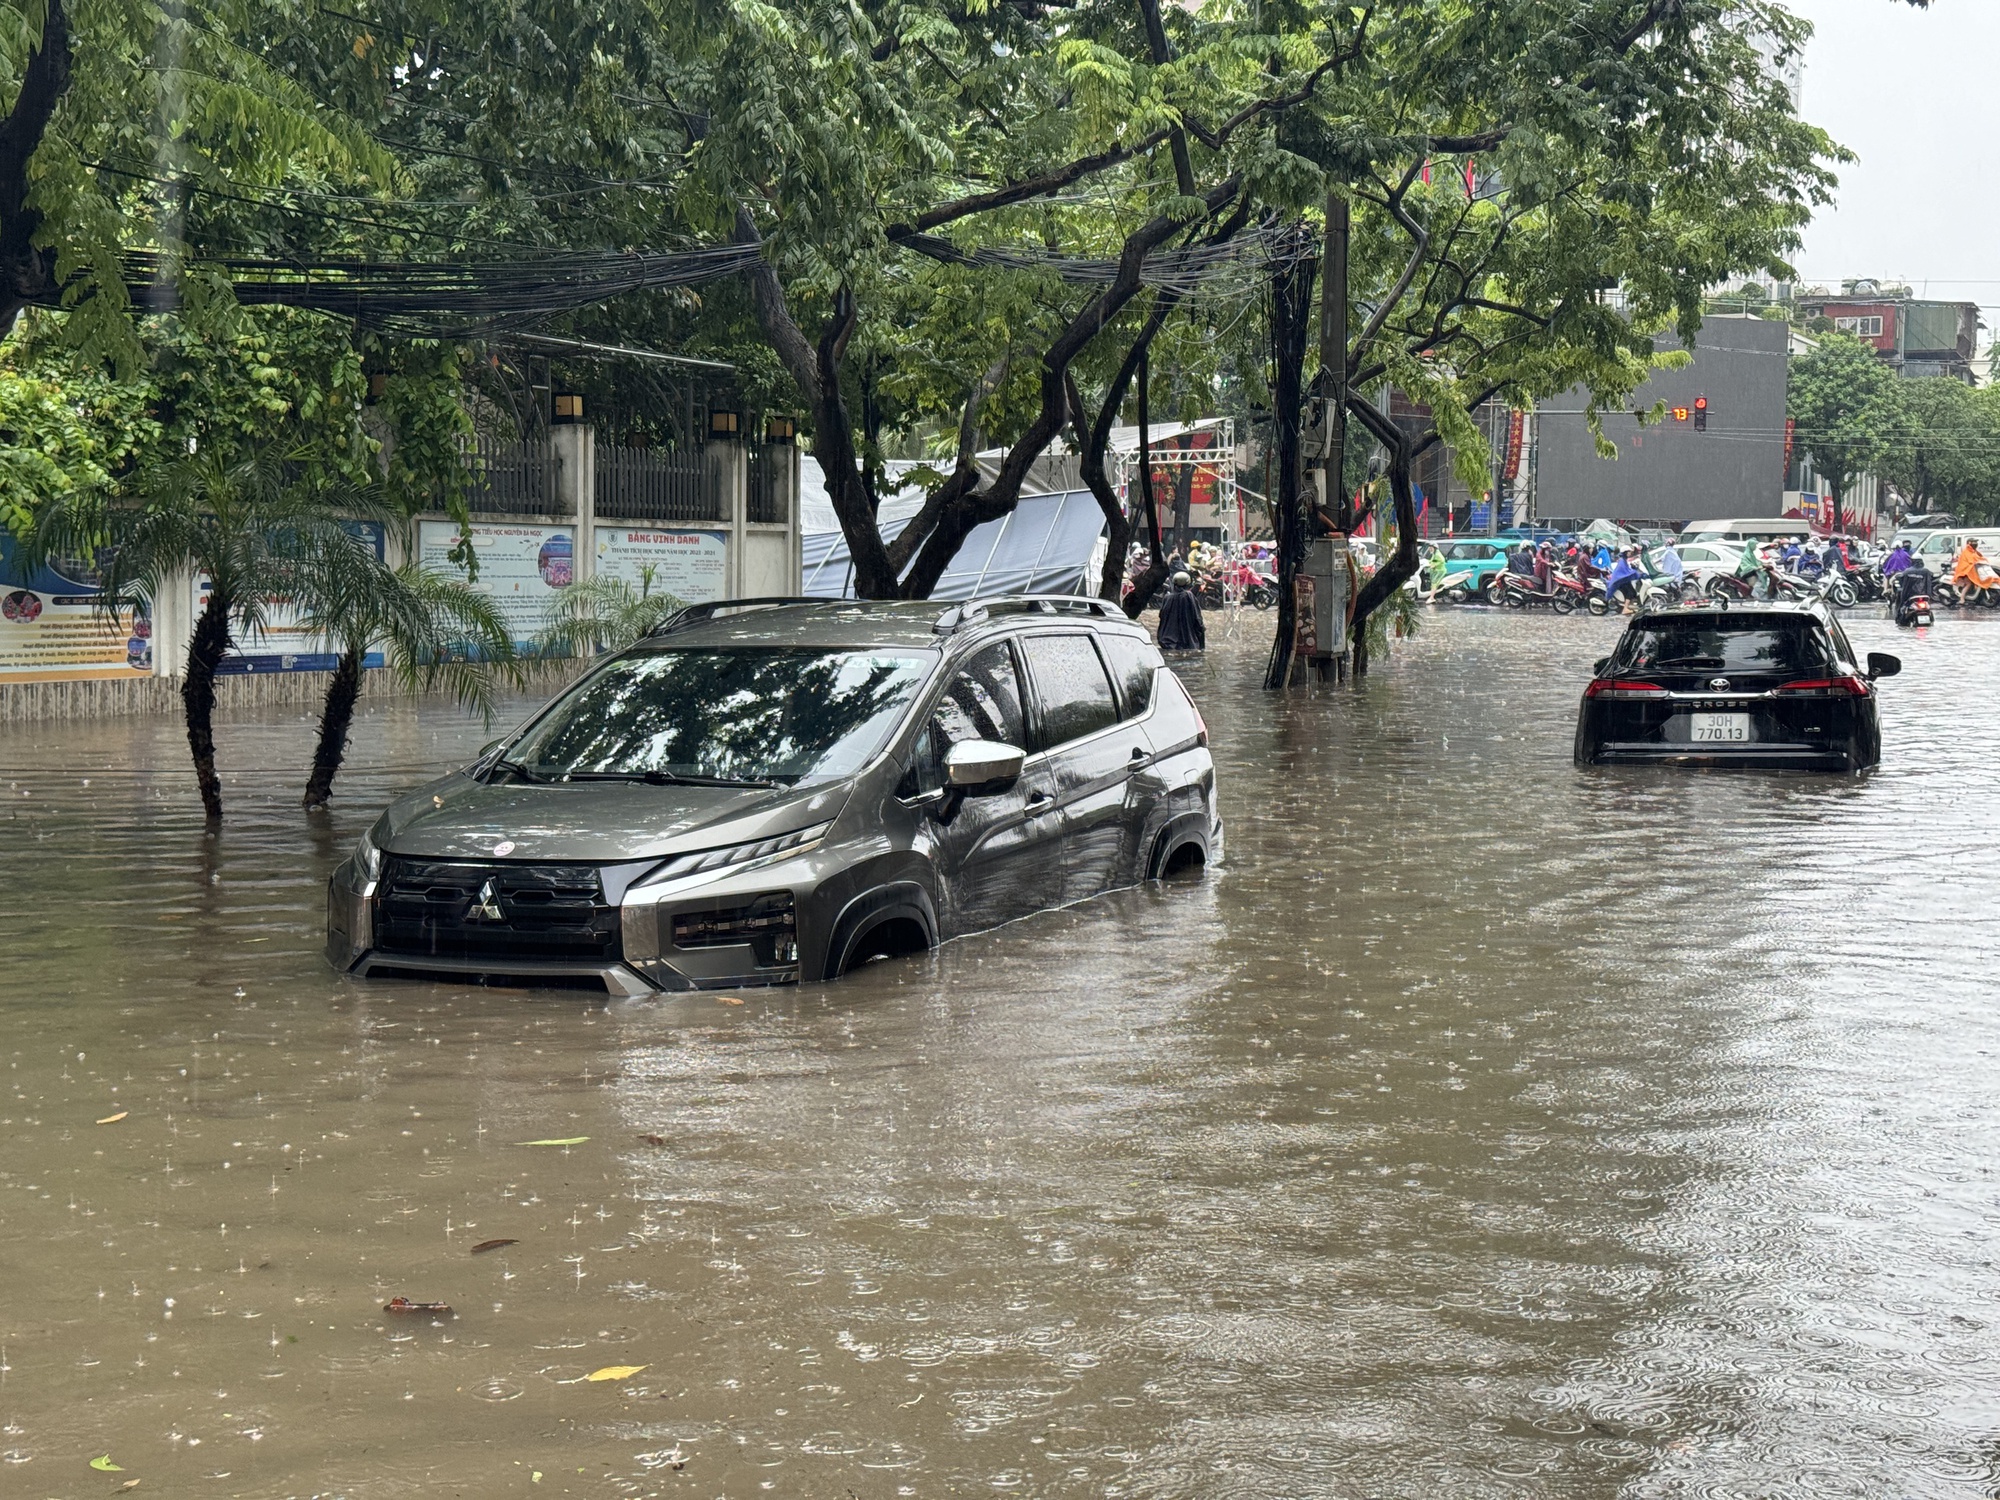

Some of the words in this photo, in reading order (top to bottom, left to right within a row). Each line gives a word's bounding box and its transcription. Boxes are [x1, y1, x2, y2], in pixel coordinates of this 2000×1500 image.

[628, 530, 651, 543] BẢNG
[653, 534, 675, 544] VINH
[677, 535, 700, 545] DANH
[1707, 715, 1733, 727] 30H
[1697, 728, 1743, 740] 770.13
